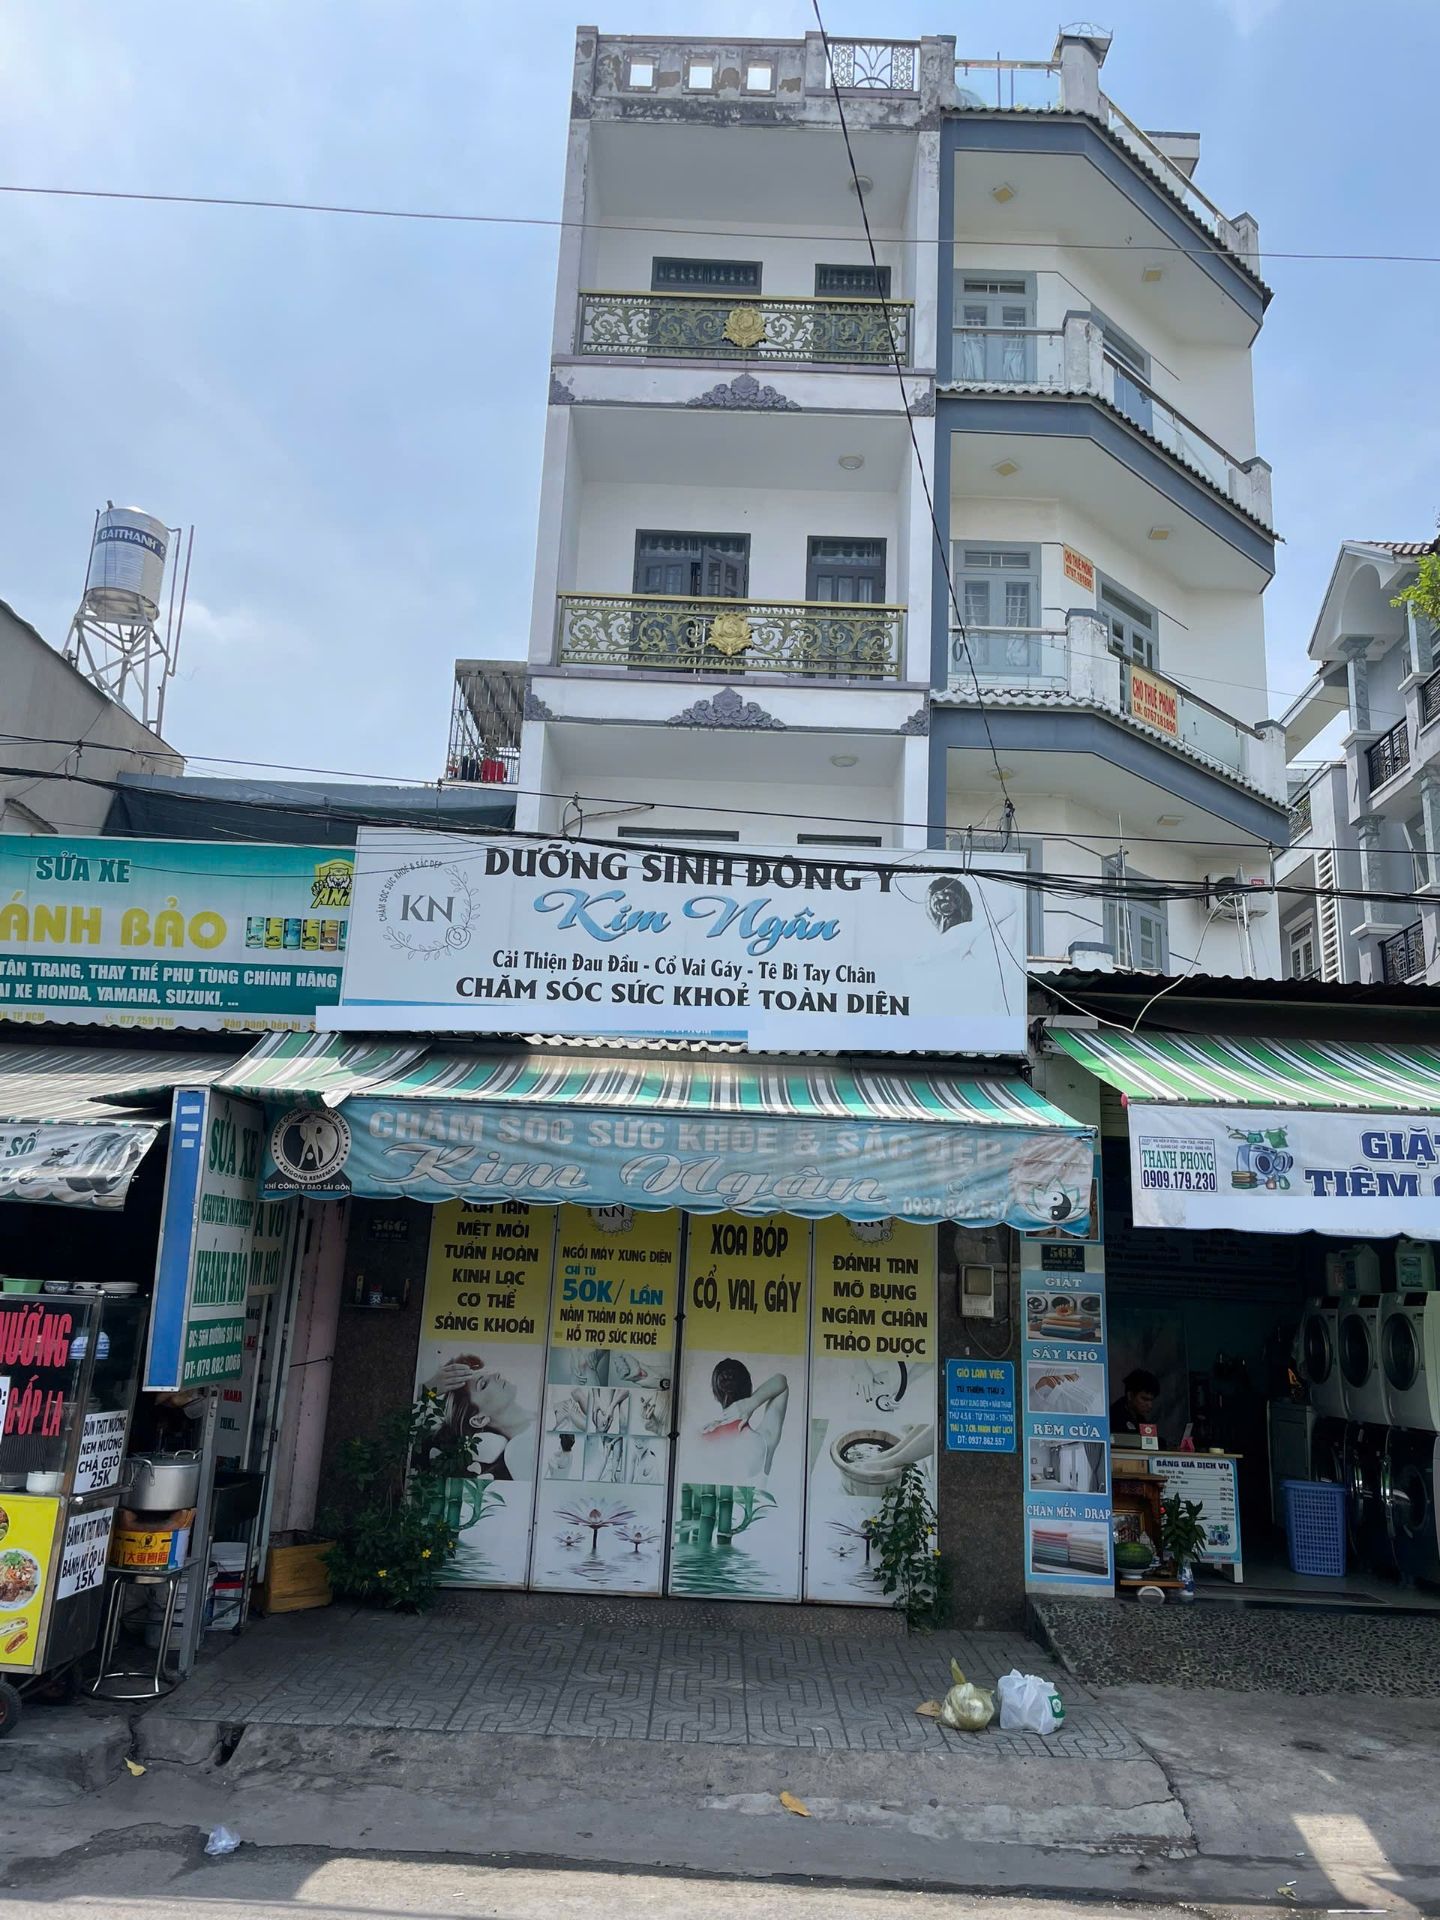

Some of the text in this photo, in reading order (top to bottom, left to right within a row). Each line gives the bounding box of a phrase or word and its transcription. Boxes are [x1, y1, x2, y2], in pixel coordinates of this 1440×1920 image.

[1133, 676, 1143, 701] CHO
[36, 851, 131, 883] SỬA XE
[484, 844, 627, 880] DƯỠNG
[642, 855, 733, 887] SINH
[400, 894, 456, 923] KN
[120, 896, 228, 950] BẢO
[533, 888, 841, 957] Kim Ngân
[32, 962, 85, 980] TRANG,
[89, 964, 126, 980] THAY
[131, 962, 159, 981] THẾ
[163, 967, 194, 985] PHỤ
[199, 967, 239, 985] TÙNG
[244, 969, 291, 986] CHÍNH
[296, 971, 337, 988] HÃNG
[492, 950, 518, 969] Cải
[524, 951, 567, 971] Thiện
[572, 954, 602, 972] Đau
[607, 954, 639, 974] Đầu
[655, 955, 678, 976] Cổ
[682, 958, 706, 977] Vai
[710, 959, 742, 982] Gáy
[758, 961, 778, 980] Tê
[783, 961, 799, 981] Bì
[803, 964, 831, 985] Tay
[835, 964, 876, 984] Chân
[15, 984, 33, 998] XE
[37, 984, 92, 1002] HONDA,
[97, 986, 161, 1004] YAMAHA,
[165, 989, 223, 1007] SUZUKI,
[456, 976, 911, 1017] CHĂM SÓC SỨC KHOẺ TOÀN DIỆN
[5, 1129, 41, 1158] SỐ
[209, 1100, 259, 1182] SỬA XE
[368, 1108, 484, 1142] CHĂM
[497, 1113, 575, 1146] SÓC
[588, 1114, 666, 1149] SỨC
[790, 1134, 819, 1157] &
[836, 1125, 913, 1160] SẮC
[1142, 1149, 1214, 1171] THANH PHONG
[368, 1142, 890, 1206] Kim Ngân
[1143, 1170, 1216, 1191] 0909.179.230
[457, 1220, 530, 1240] MỆT MỎI
[710, 1220, 788, 1258] XOA BÓP
[491, 1245, 539, 1262] HOÀN
[591, 1247, 672, 1266] MÁY XUNG ĐIỆN
[832, 1253, 919, 1275] ĐÁNH TAN
[452, 1268, 525, 1288] KINH LẠC
[693, 1264, 801, 1314] CỔ, VAI, GÁY
[487, 1288, 516, 1309] THỂ
[870, 1283, 917, 1304] BỤNG
[434, 1311, 535, 1334] SẢNG KHOÁI
[619, 1309, 633, 1325] ĐÁ
[636, 1310, 666, 1326] NÓNG
[822, 1305, 928, 1328] NGÂM CHÂN
[566, 1324, 657, 1346] HỖ TRỢ SỨC KHOẺ
[824, 1331, 926, 1358] THẢO DƯỢC
[1032, 1346, 1098, 1361] SẤY KHÔ
[197, 1355, 224, 1378] 079 882
[42, 1390, 64, 1436] LA
[84, 1416, 96, 1437] BÚN
[1033, 1421, 1100, 1438] RÈM CỬA
[80, 1435, 122, 1456] NEM NƯỚNG
[78, 1451, 119, 1474] CHẢ GIÒ
[90, 1469, 111, 1488] 25K
[1085, 1508, 1111, 1520] DRAP
[66, 1518, 80, 1547] BÁNH
[62, 1553, 82, 1578] BÁNH
[88, 1545, 98, 1570] ỐP
[97, 1547, 105, 1566] LA
[74, 1568, 97, 1591] 15K
